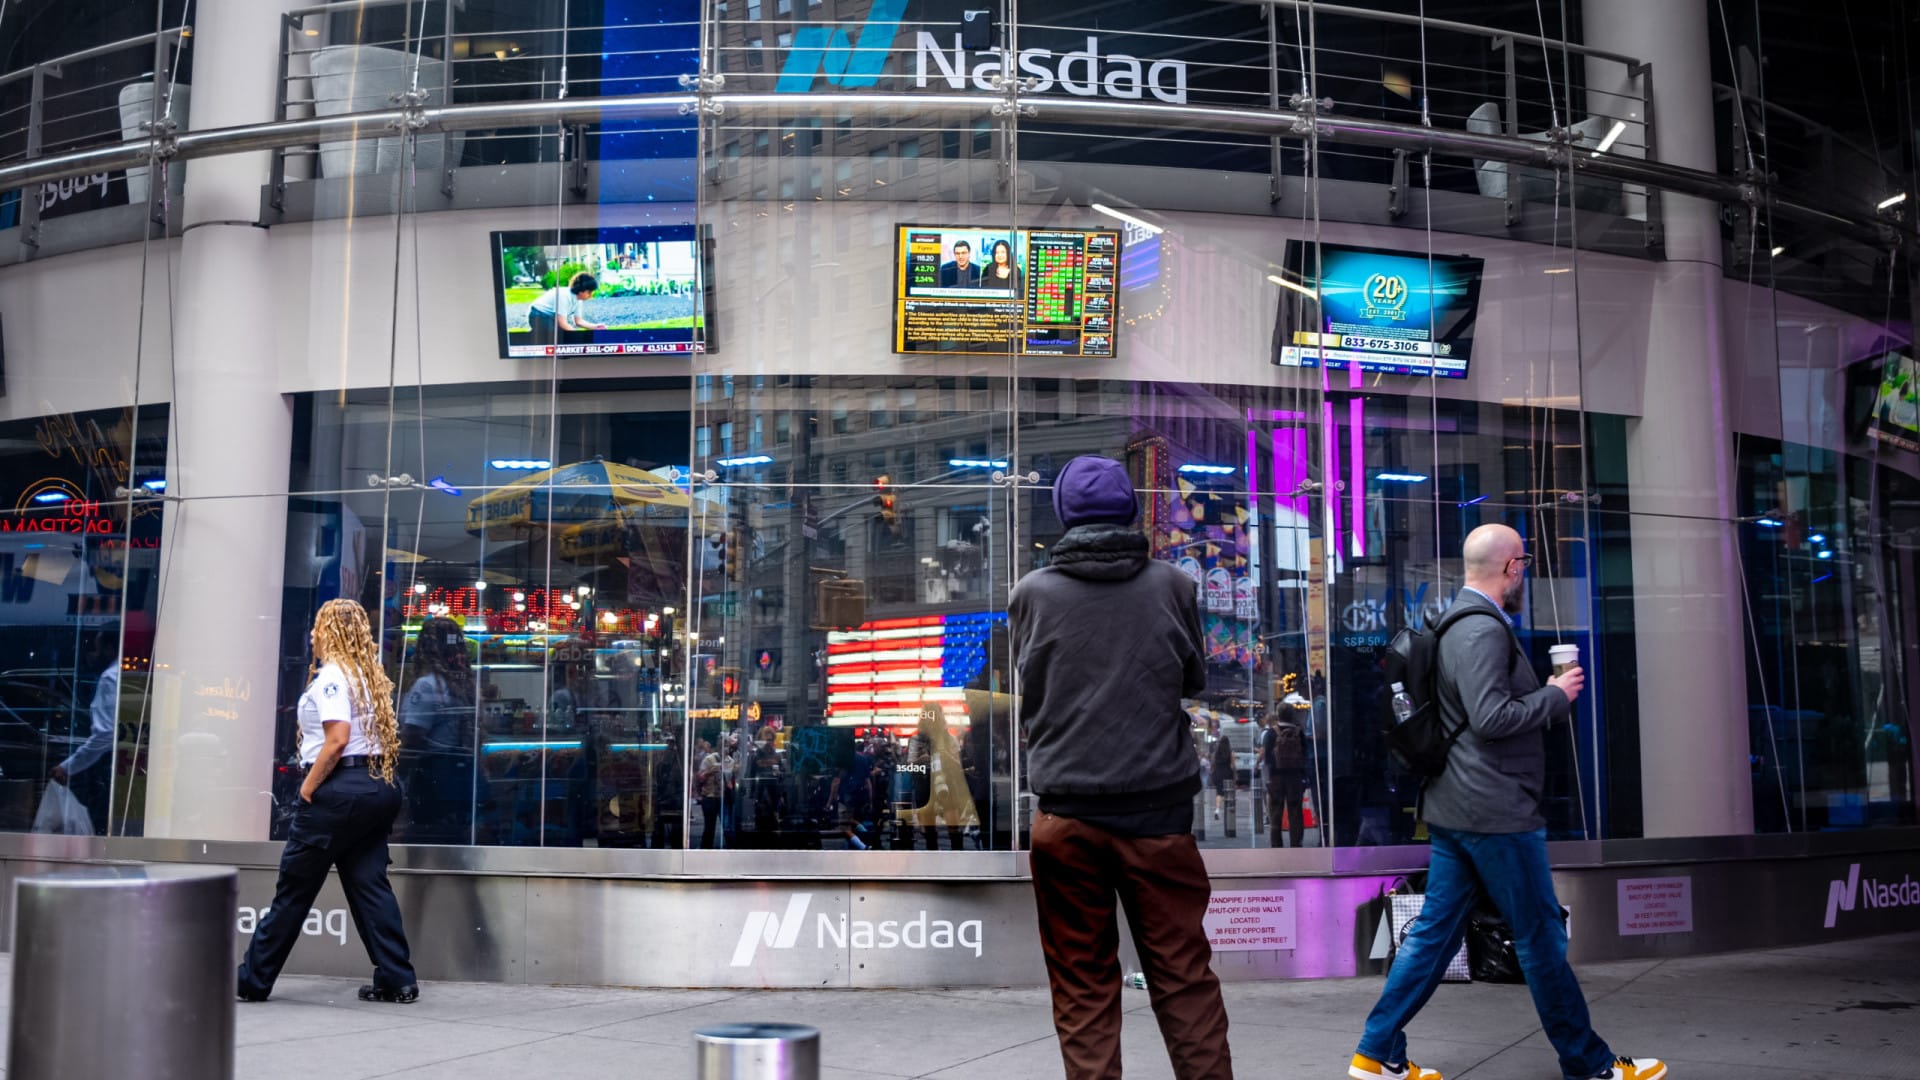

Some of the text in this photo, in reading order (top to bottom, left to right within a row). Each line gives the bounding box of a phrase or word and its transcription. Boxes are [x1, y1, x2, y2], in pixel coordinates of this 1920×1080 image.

[916, 31, 1187, 104] Nasdaq
[1373, 275, 1403, 299] 20+
[556, 345, 618, 354] MARKET SELL-OFF
[626, 345, 643, 353] DOW
[1344, 337, 1419, 352] 833-675-3106
[1344, 636, 1365, 647] S&P
[896, 762, 927, 775] asdaq
[1862, 873, 1920, 909] Nasda
[1247, 895, 1285, 903] SPRINKLER
[817, 910, 983, 958] Nasdaq
[1242, 926, 1276, 934] OPPOSITE
[1262, 936, 1288, 944] STREET
